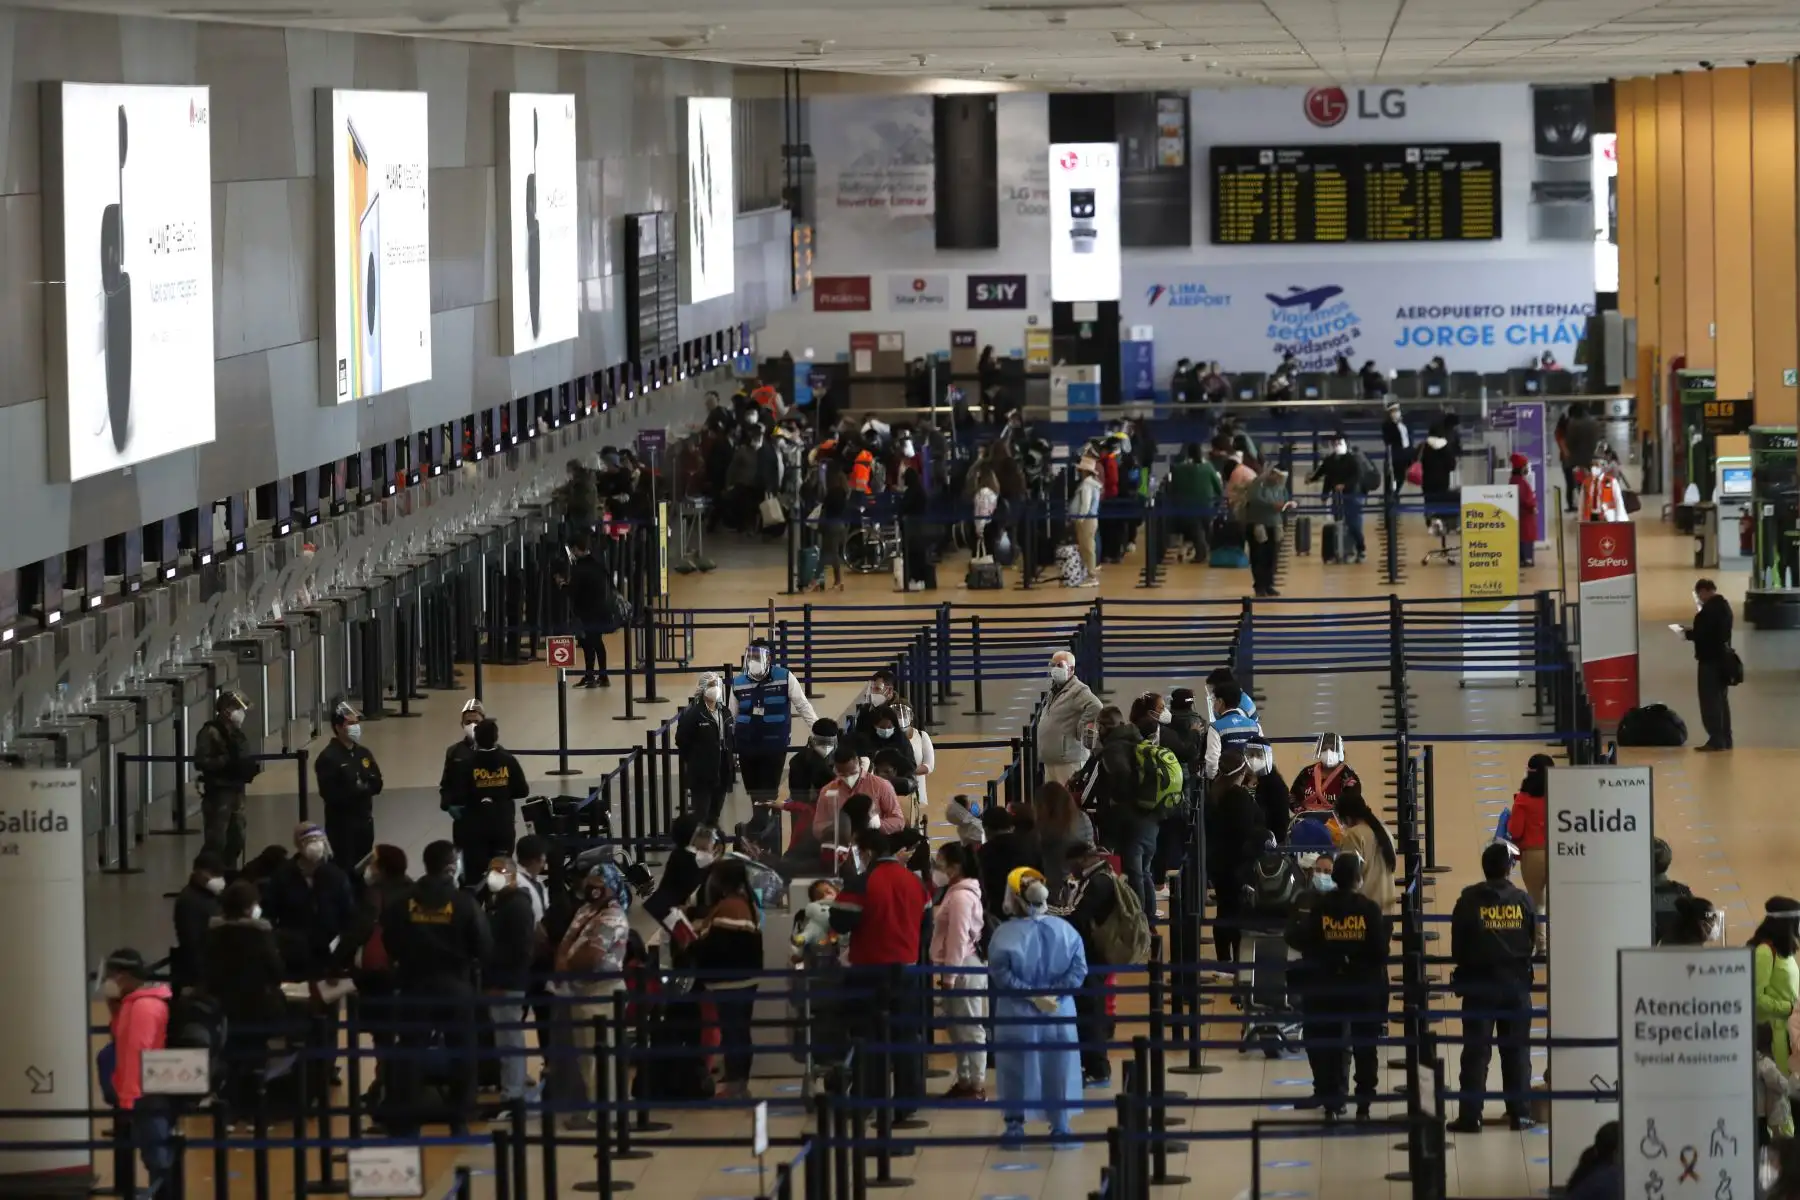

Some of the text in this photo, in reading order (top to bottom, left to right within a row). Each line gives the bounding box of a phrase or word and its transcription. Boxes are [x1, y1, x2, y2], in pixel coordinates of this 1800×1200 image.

[1357, 89, 1407, 119] LG
[1010, 187, 1029, 200] LG
[975, 283, 1018, 301] SKY
[1168, 284, 1208, 295] LIMA
[1168, 295, 1232, 307] AIRPORT
[1271, 302, 1349, 328] Viajemos
[1396, 304, 1505, 320] AEROPUERTO
[1266, 312, 1362, 343] seguros
[1273, 326, 1361, 355] ayudanos a
[1394, 325, 1495, 347] JORGE
[1466, 509, 1485, 519] Fila
[1466, 520, 1506, 532] Express
[1468, 541, 1489, 550] Más
[1469, 551, 1502, 561] tiempo
[1469, 558, 1499, 569] para ti
[1608, 779, 1646, 788] LATAM
[1557, 808, 1637, 833] Salida
[1557, 842, 1586, 857] Exit
[1479, 903, 1524, 921] POLICIA
[1322, 914, 1367, 931] POLICIA
[1698, 964, 1746, 976] LATAM
[1634, 996, 1743, 1016] Atenciones
[1634, 1019, 1740, 1046] Especiales
[1634, 1051, 1738, 1067] Special Assistance
